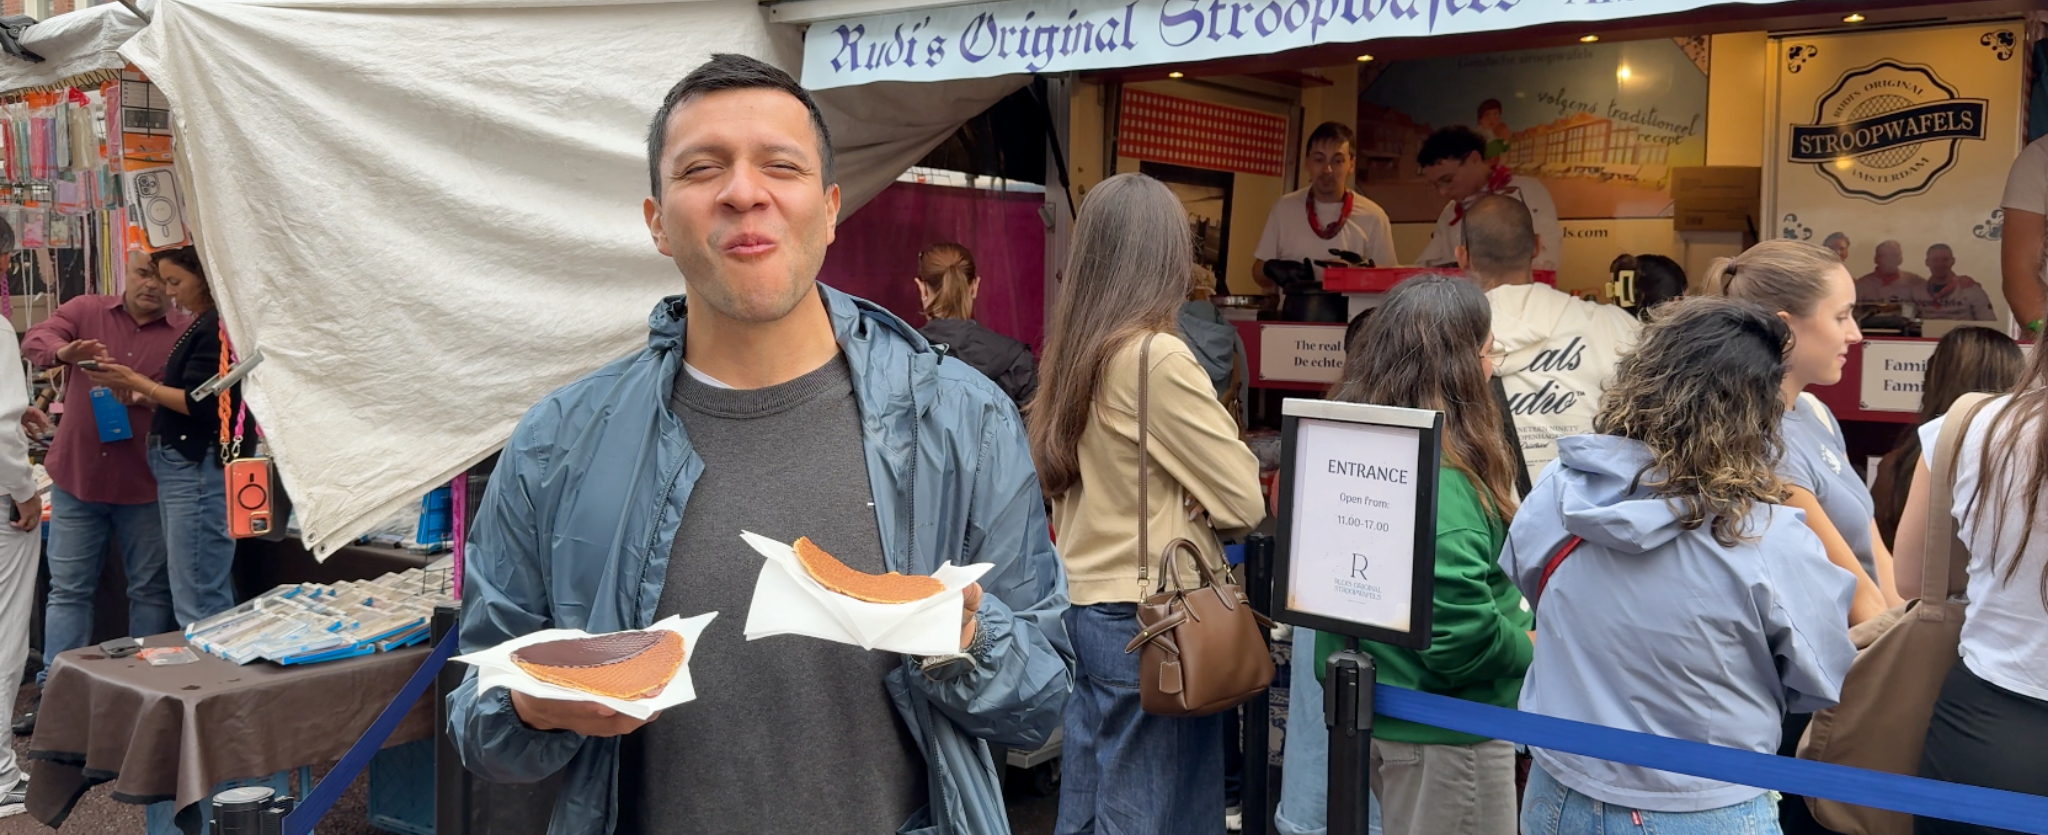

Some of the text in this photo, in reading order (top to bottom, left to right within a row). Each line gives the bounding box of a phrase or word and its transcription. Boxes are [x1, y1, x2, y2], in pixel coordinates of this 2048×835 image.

[829, 0, 1532, 73] Rudi's Original Stroopwafe
[1864, 80, 1925, 98] ORIGINAL
[1537, 88, 1700, 136] volgens traditioneel
[1636, 131, 1685, 146] recept
[1799, 110, 1974, 155] STROOPWAFELS
[1852, 157, 1930, 184] AMSTERDAM
[1295, 340, 1341, 352] The real
[1294, 356, 1309, 367] De
[1328, 459, 1408, 485] ENTRANCE
[1339, 492, 1390, 510] Open from:
[1337, 515, 1389, 533] 11.00-17.00
[1350, 553, 1368, 580] R
